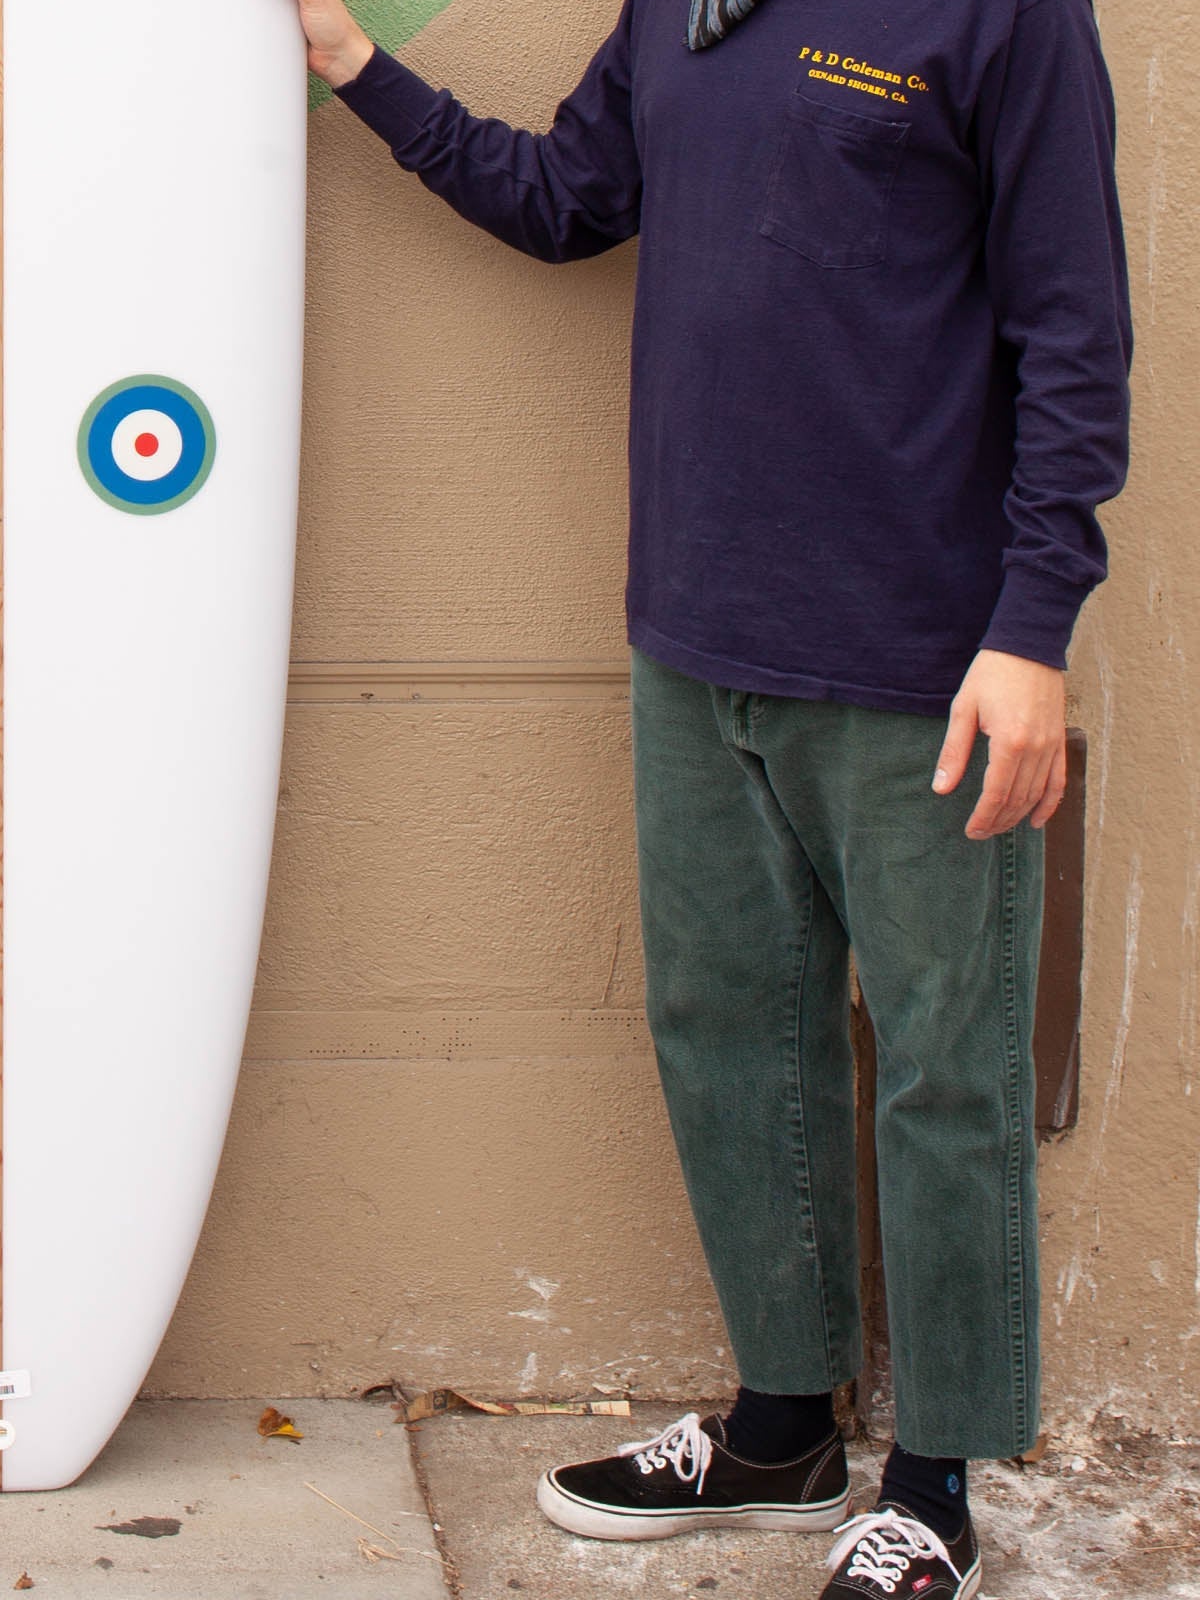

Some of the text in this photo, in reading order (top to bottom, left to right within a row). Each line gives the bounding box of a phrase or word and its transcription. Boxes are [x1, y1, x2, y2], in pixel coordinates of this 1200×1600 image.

[799, 47, 929, 91] P & D Coleman Co.
